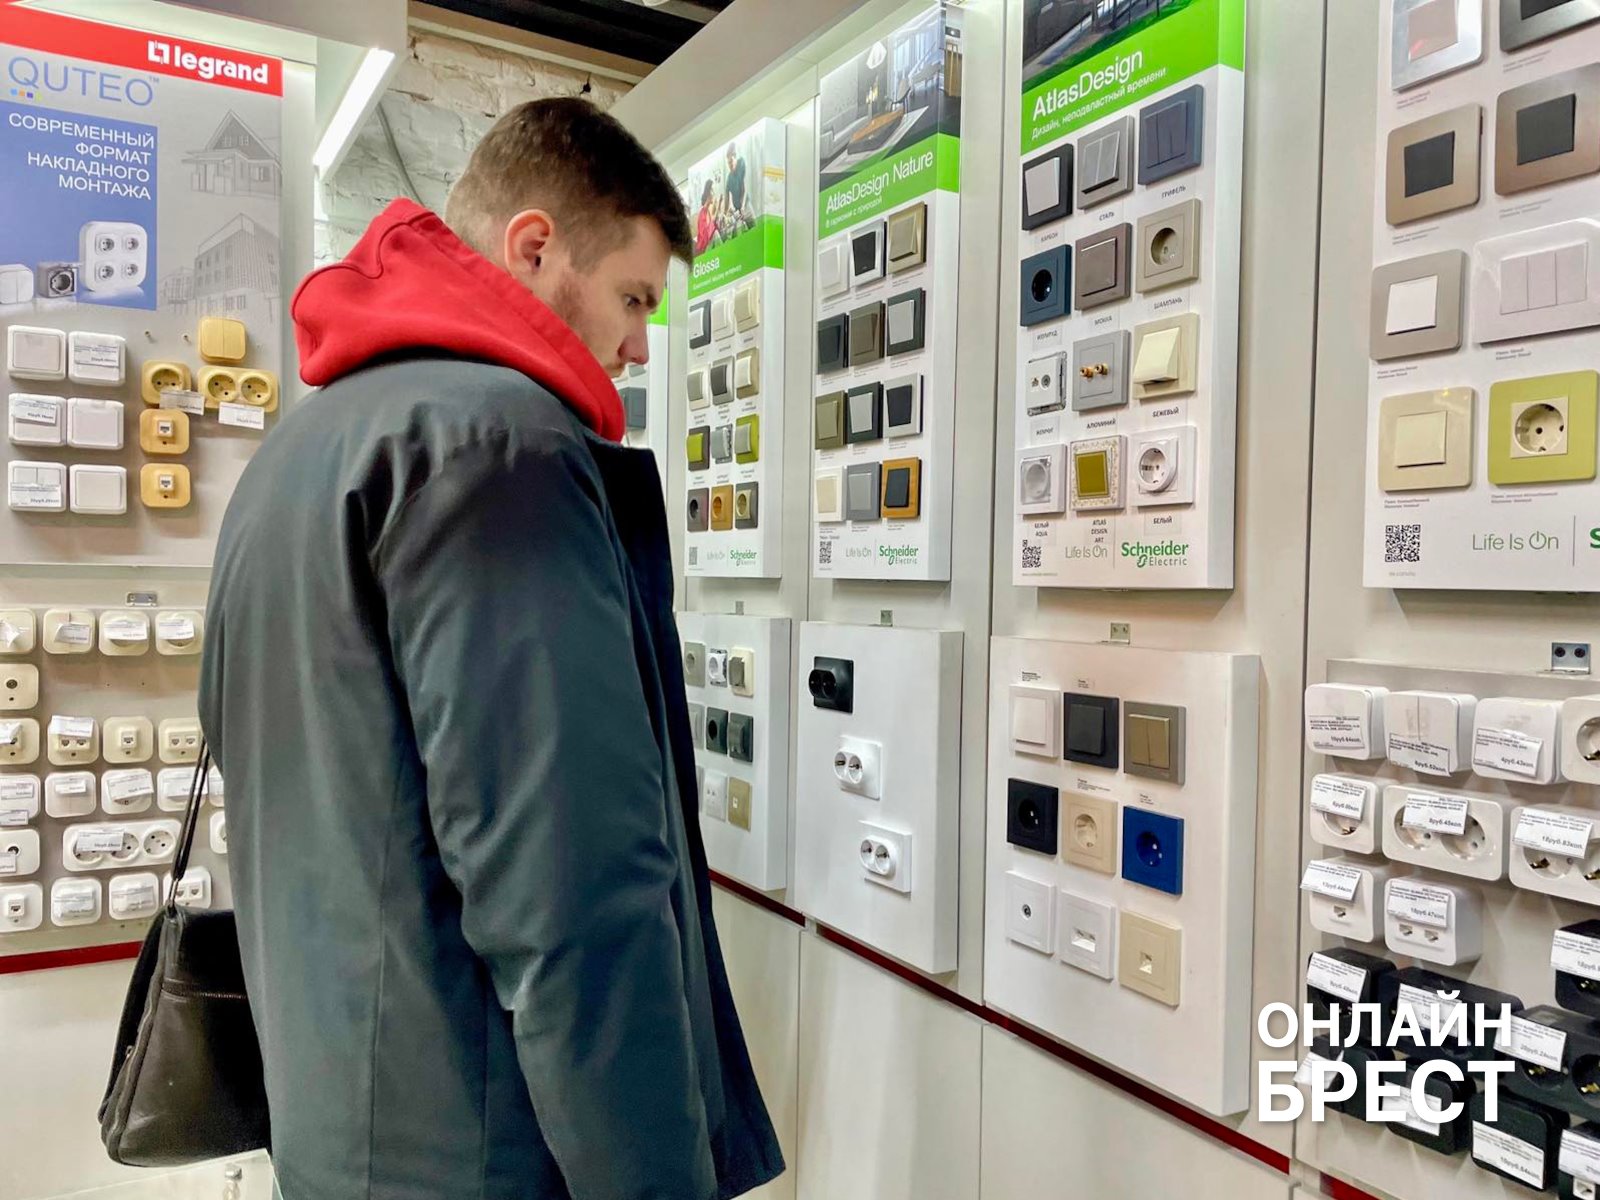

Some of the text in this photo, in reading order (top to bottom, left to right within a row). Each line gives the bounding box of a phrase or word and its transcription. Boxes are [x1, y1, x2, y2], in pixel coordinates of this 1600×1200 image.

[174, 45, 269, 84] legrand
[8, 56, 154, 106] QUTEO
[1032, 50, 1143, 121] AtlasDesign
[1031, 67, 1167, 141] Дизайн, неподвластный времени
[9, 113, 155, 149] СОВРЕМЕННЫЙ
[75, 142, 151, 166] ФОРМАТ
[27, 152, 150, 184] НАКЛАДНОГО
[58, 175, 151, 200] МОНТАЖА
[825, 151, 933, 215] AtlasDesign Nature
[1161, 185, 1186, 199] ГРИФЕЛЬ
[1099, 211, 1115, 222] СТАЛЬ
[693, 256, 720, 278] Glossa
[1152, 406, 1179, 418] БЕЖЕВЫЙ
[1153, 516, 1173, 525] БЕЛЫЙ
[879, 545, 919, 557] Schneider
[1065, 544, 1108, 559] Life Is On
[1121, 540, 1189, 557] Schneider
[1472, 531, 1559, 551] Life Is On
[1149, 556, 1188, 567] Electric
